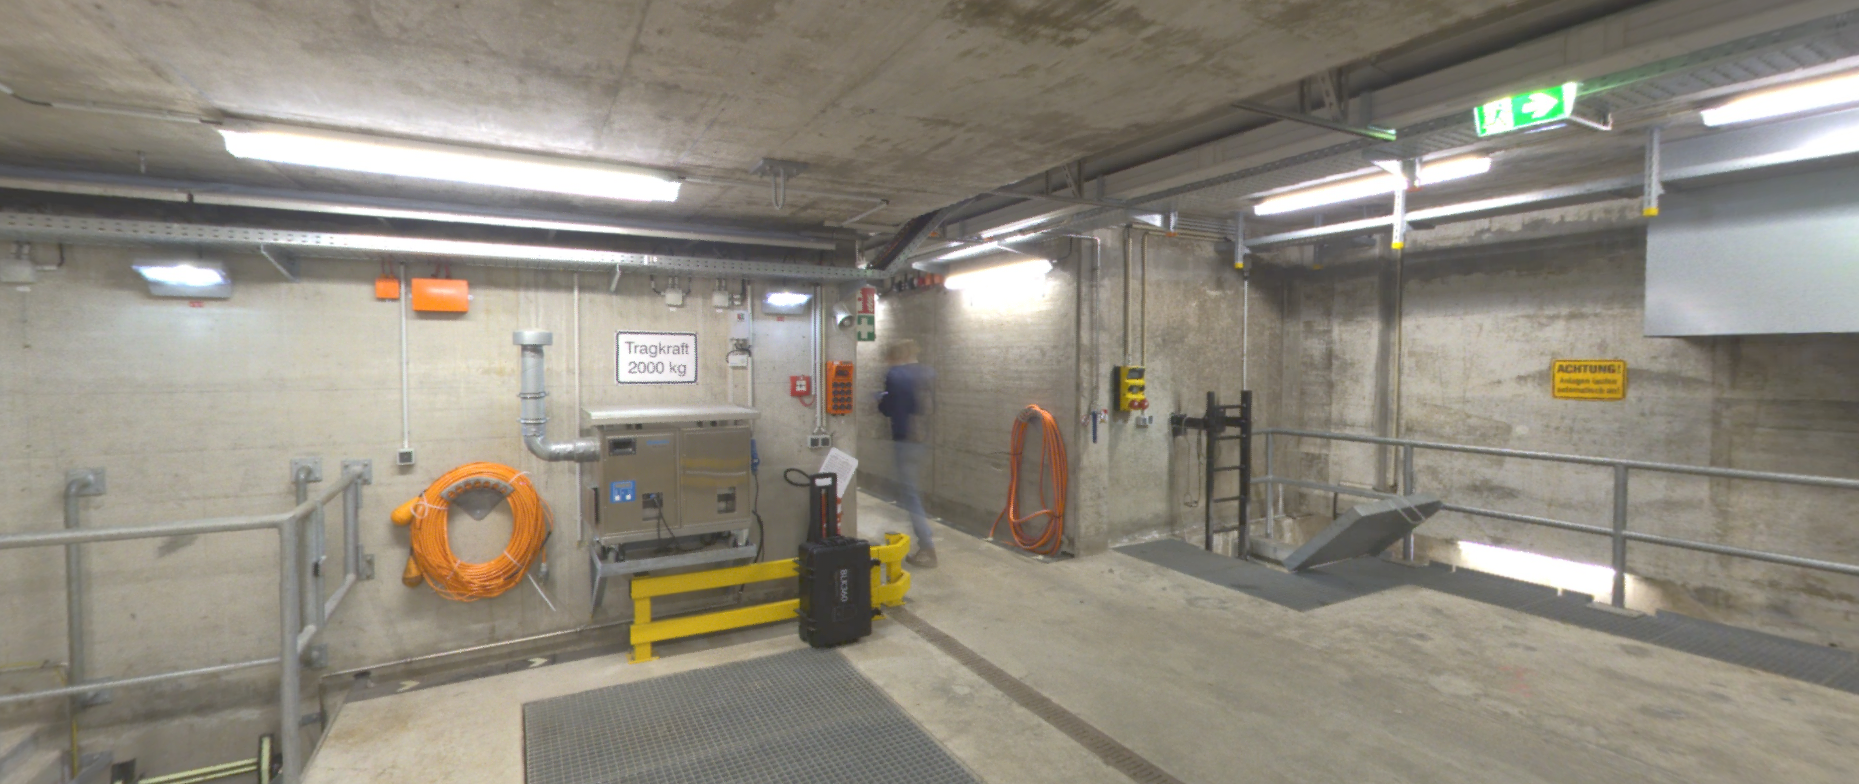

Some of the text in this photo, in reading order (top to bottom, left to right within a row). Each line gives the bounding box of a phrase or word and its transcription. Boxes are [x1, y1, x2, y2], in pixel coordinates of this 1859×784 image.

[625, 341, 689, 358] Tragkraft
[628, 361, 687, 377] 2000 kg
